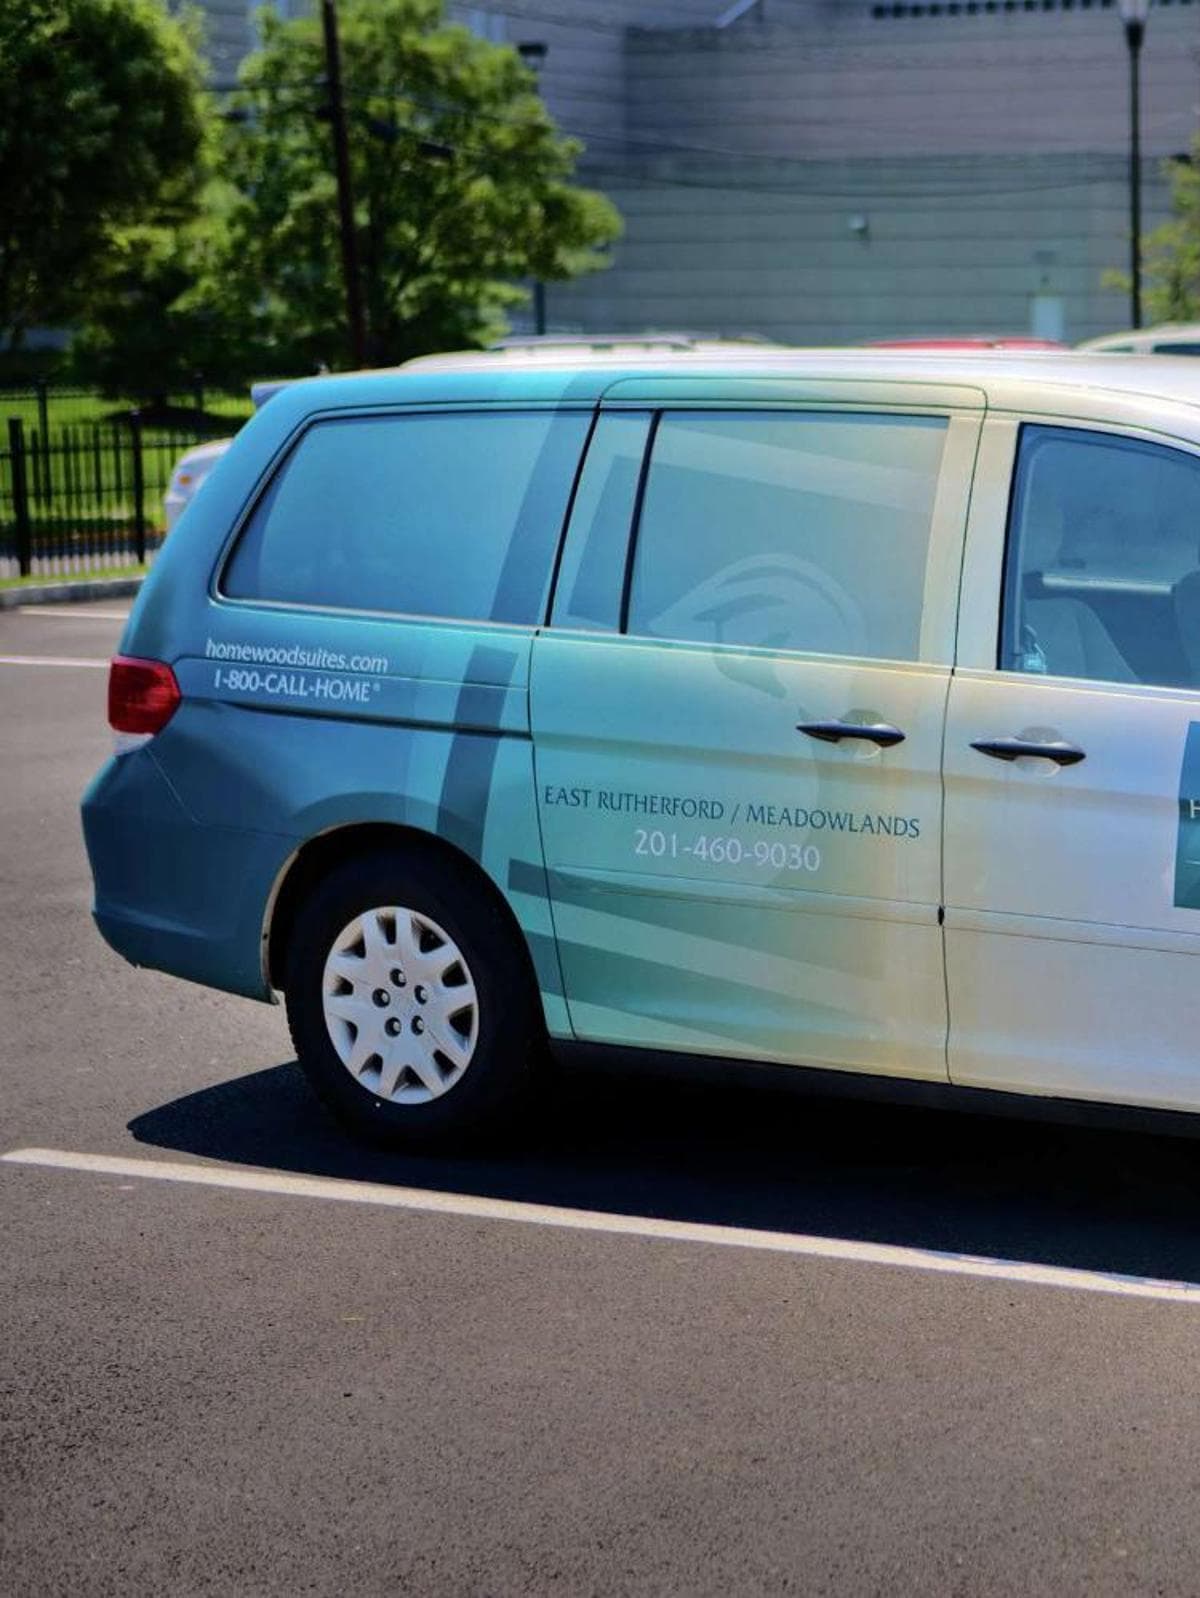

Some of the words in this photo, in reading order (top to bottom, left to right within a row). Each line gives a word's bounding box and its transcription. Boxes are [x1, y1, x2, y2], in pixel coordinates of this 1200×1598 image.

[205, 639, 388, 674] homewoodsuites.com
[214, 669, 371, 702] 1-800-CALL-HOME
[545, 786, 591, 807] EAST
[599, 791, 724, 820] RUTHERFORD
[746, 806, 921, 838] MEADOWLANDS
[635, 829, 821, 872] 201-460-9030
